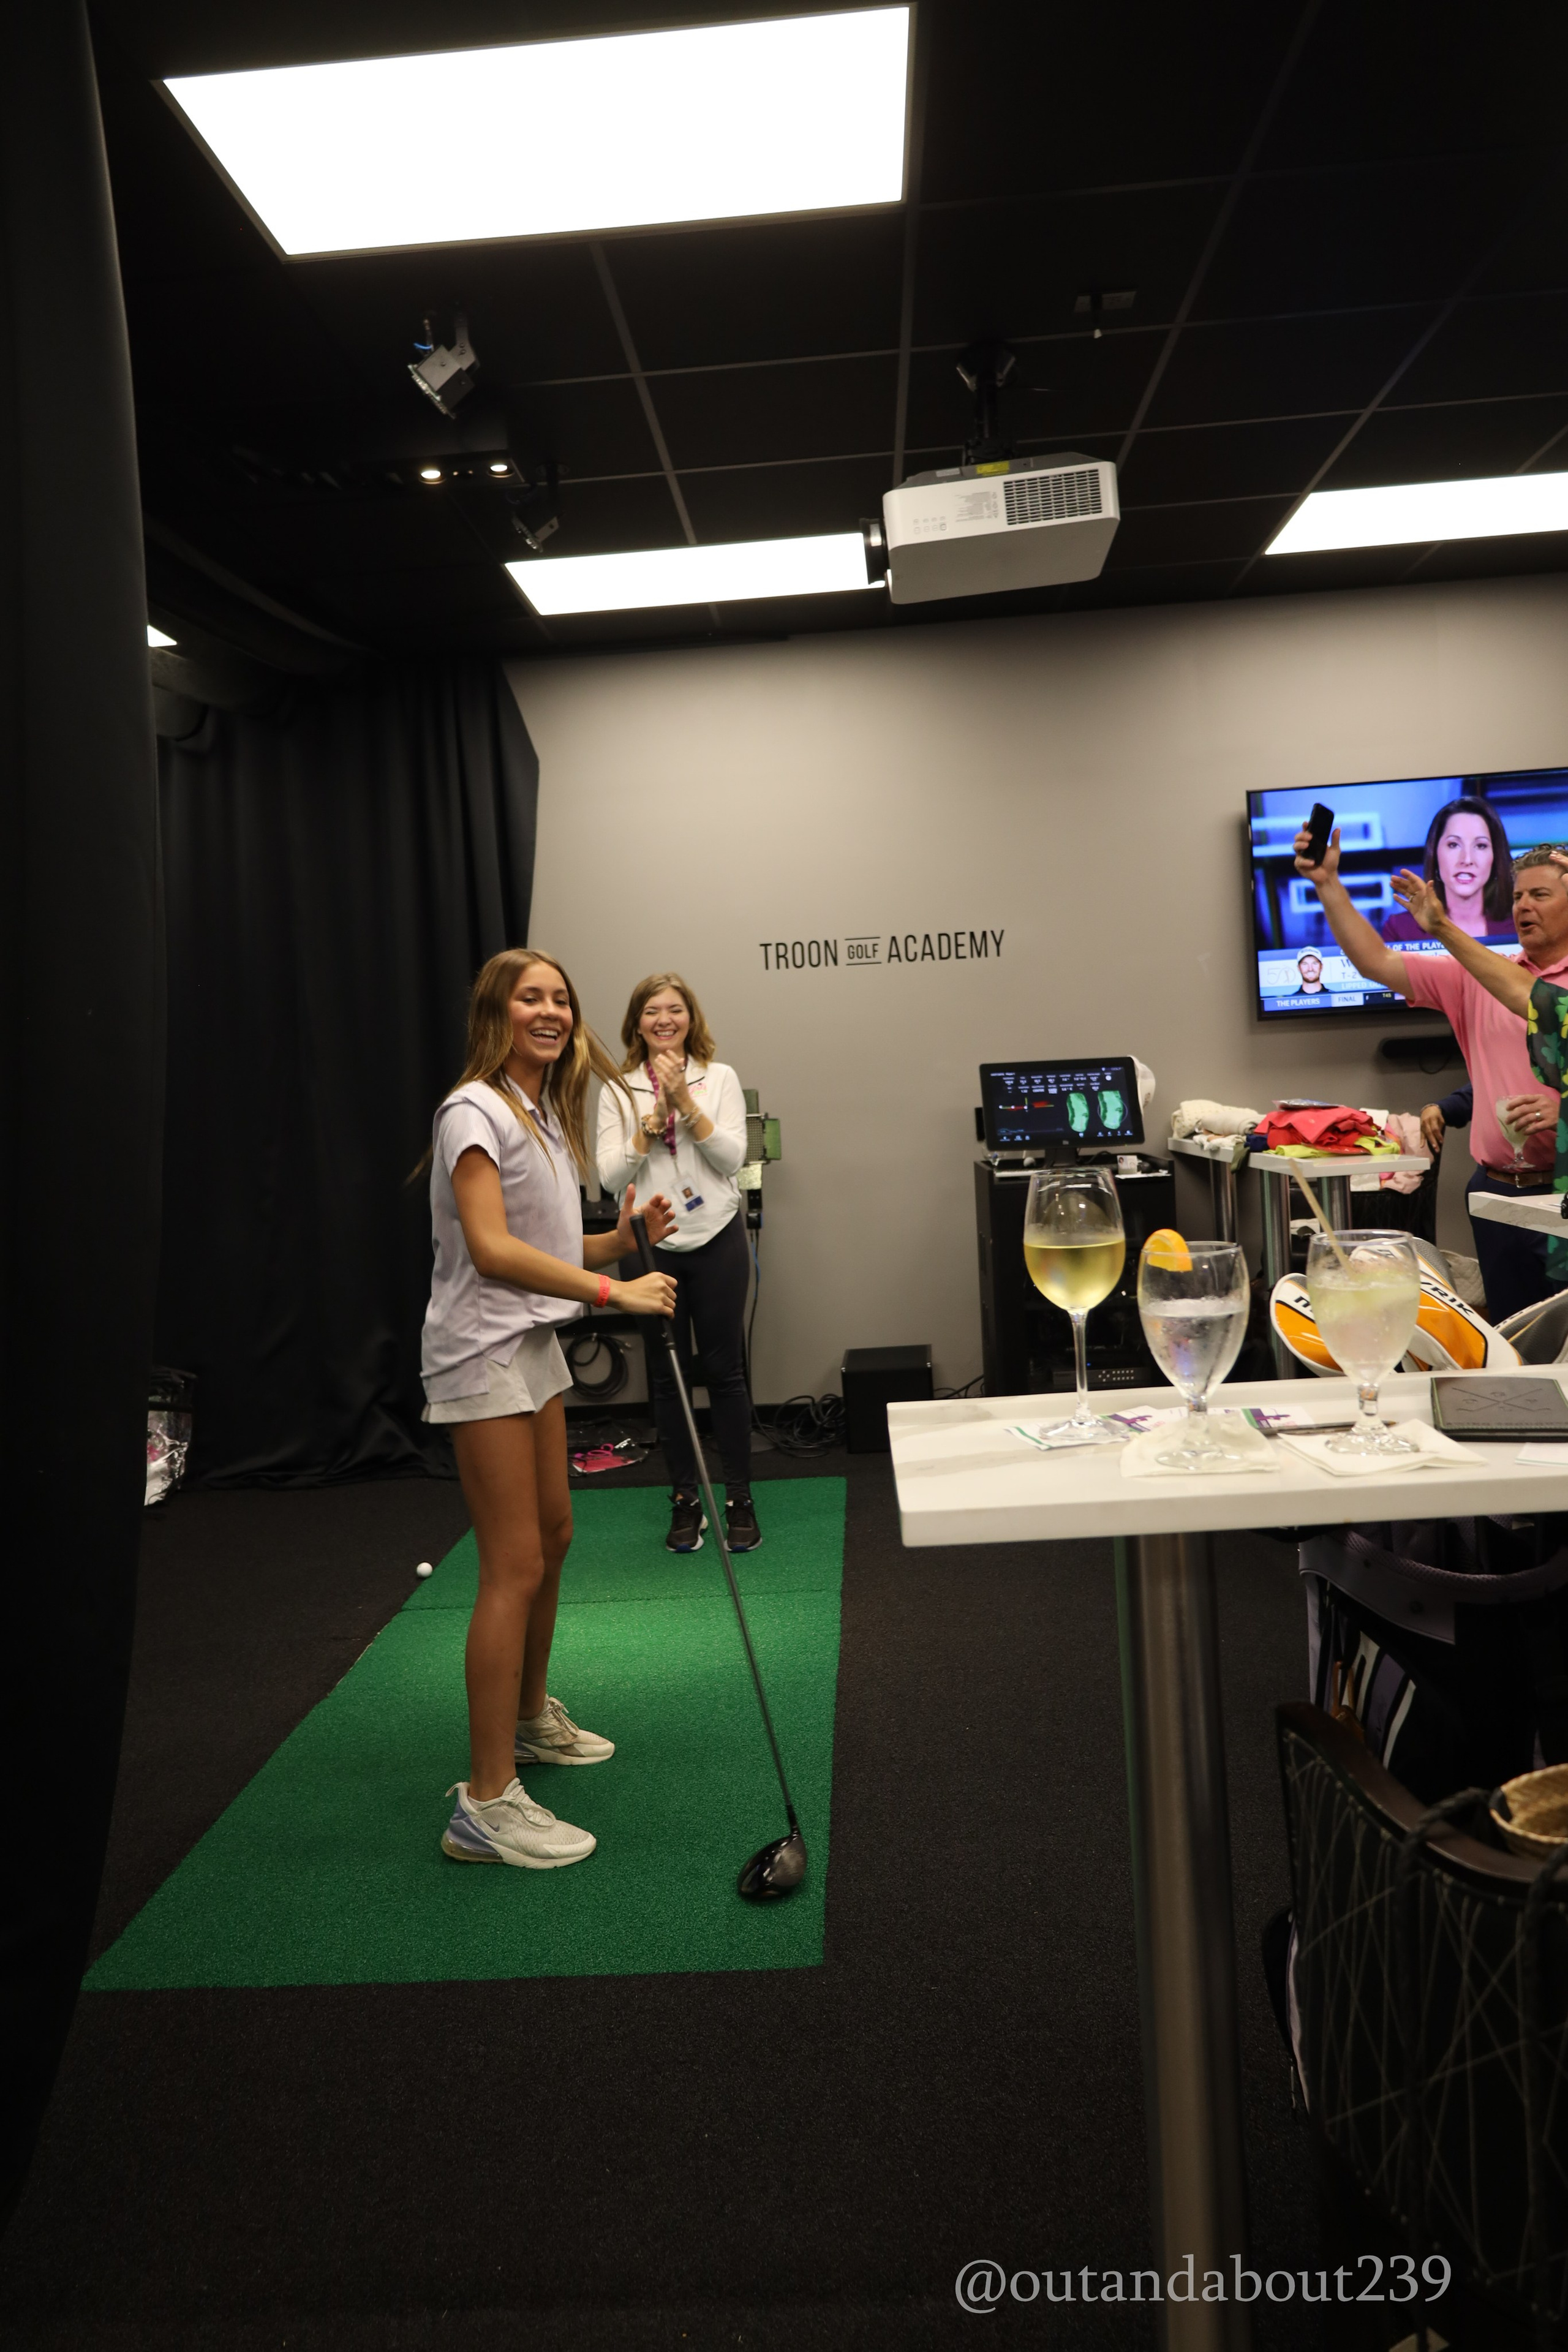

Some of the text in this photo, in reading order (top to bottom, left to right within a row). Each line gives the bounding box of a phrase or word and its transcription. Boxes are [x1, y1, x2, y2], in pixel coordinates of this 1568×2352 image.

[760, 929, 1005, 970] TROON GOLF ACADEMY
[1291, 998, 1321, 1006] PLAYERS
